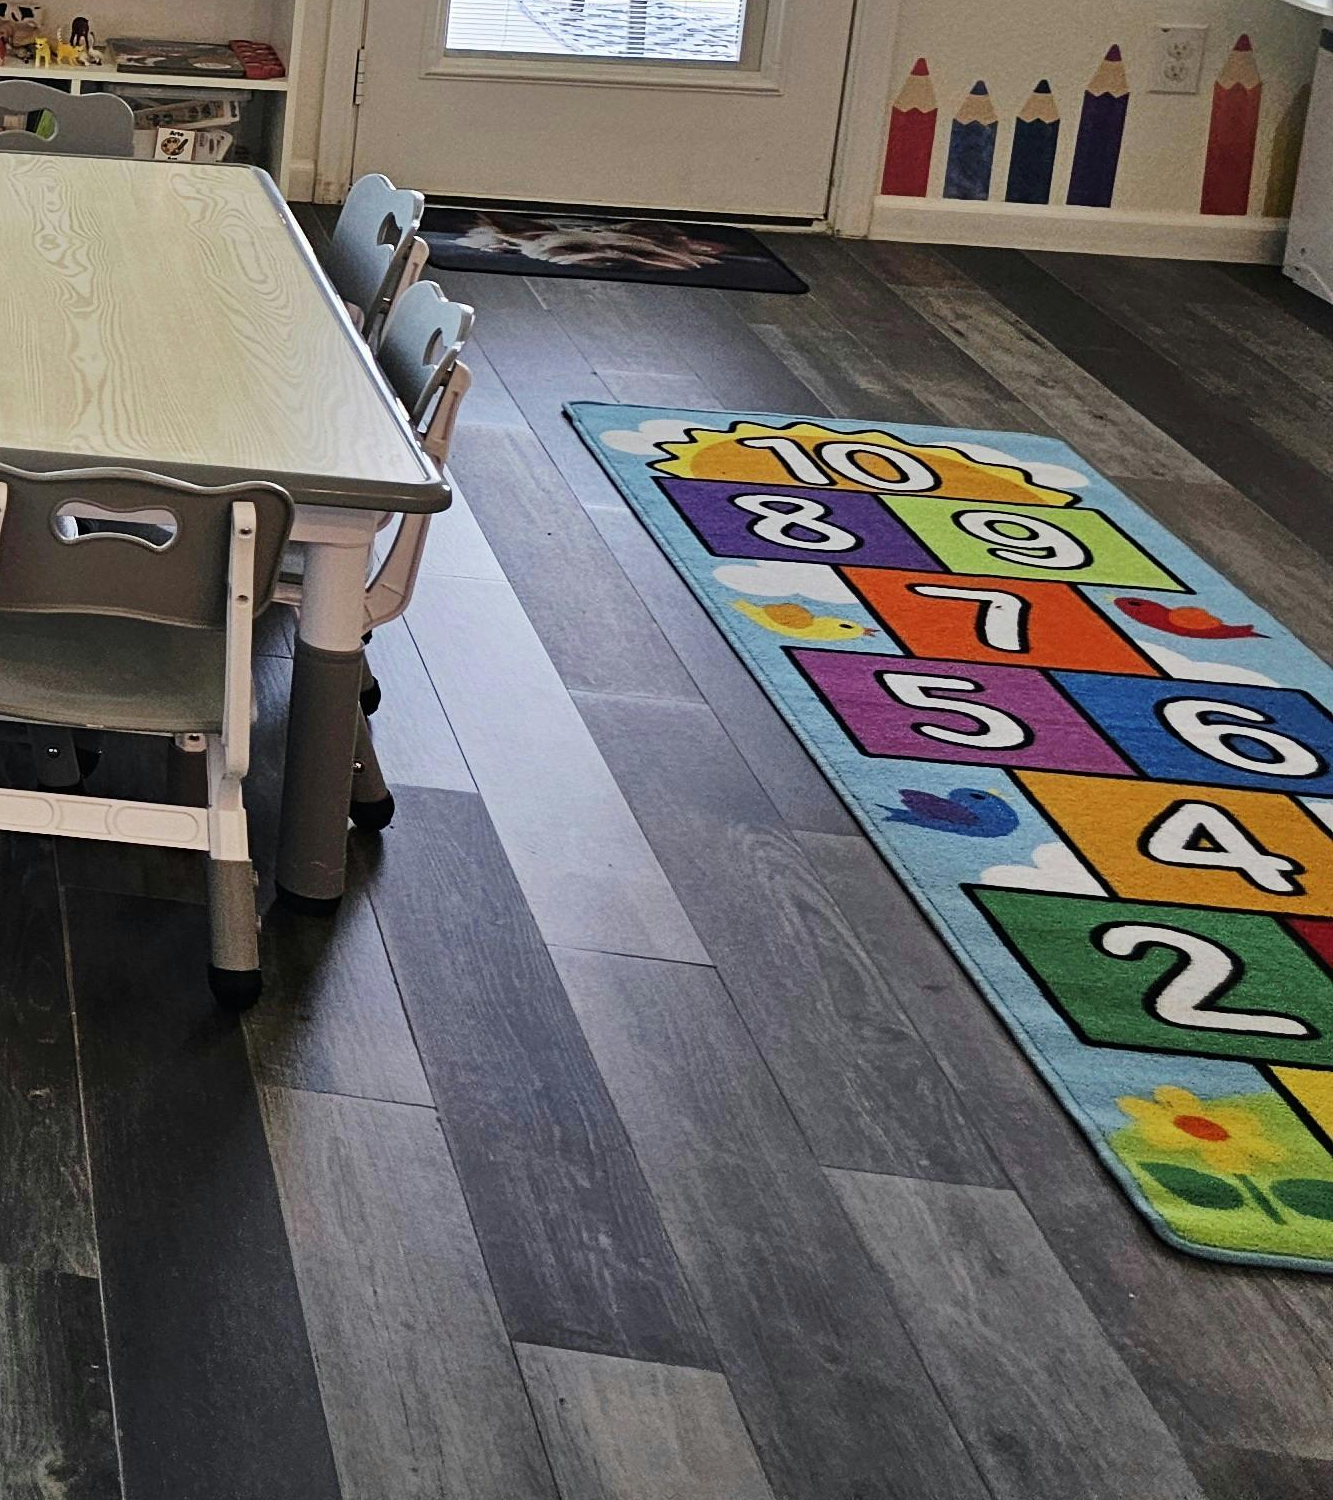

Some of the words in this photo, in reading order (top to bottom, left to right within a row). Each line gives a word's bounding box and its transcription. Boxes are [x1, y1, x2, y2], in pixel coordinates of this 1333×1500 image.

[742, 436, 941, 494] 10
[733, 493, 863, 553] 8
[958, 509, 1093, 570] 9
[907, 583, 1031, 653] 7
[881, 671, 1035, 751] 5
[1157, 699, 1328, 781] 6
[1141, 801, 1305, 897] 4
[1093, 924, 1320, 1041] 2
